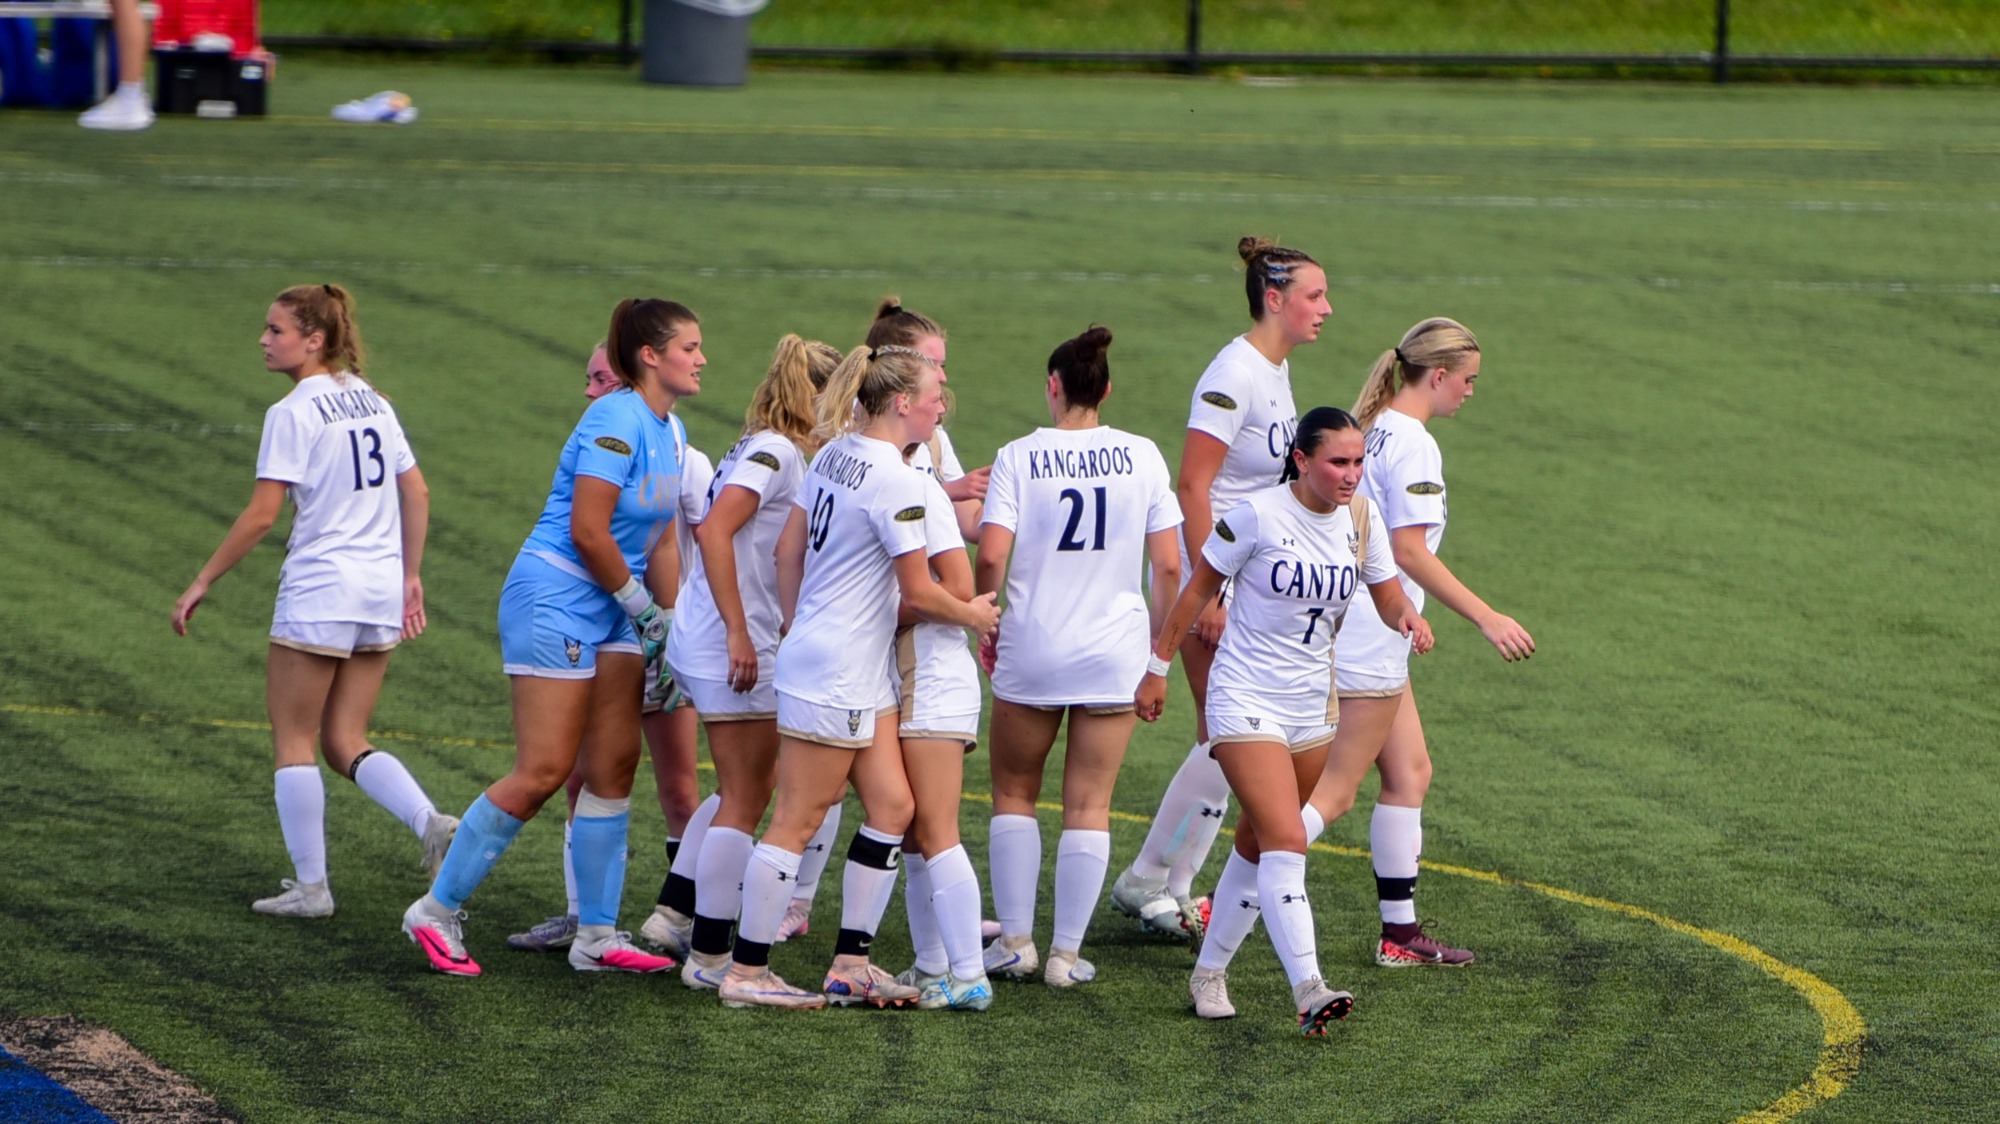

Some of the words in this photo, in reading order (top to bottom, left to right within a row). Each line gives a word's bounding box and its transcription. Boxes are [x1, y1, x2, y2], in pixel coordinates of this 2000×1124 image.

[348, 427, 385, 492] 13
[1029, 446, 1133, 480] KANGAROOS
[1056, 486, 1107, 551] 21
[1302, 608, 1325, 644] 7
